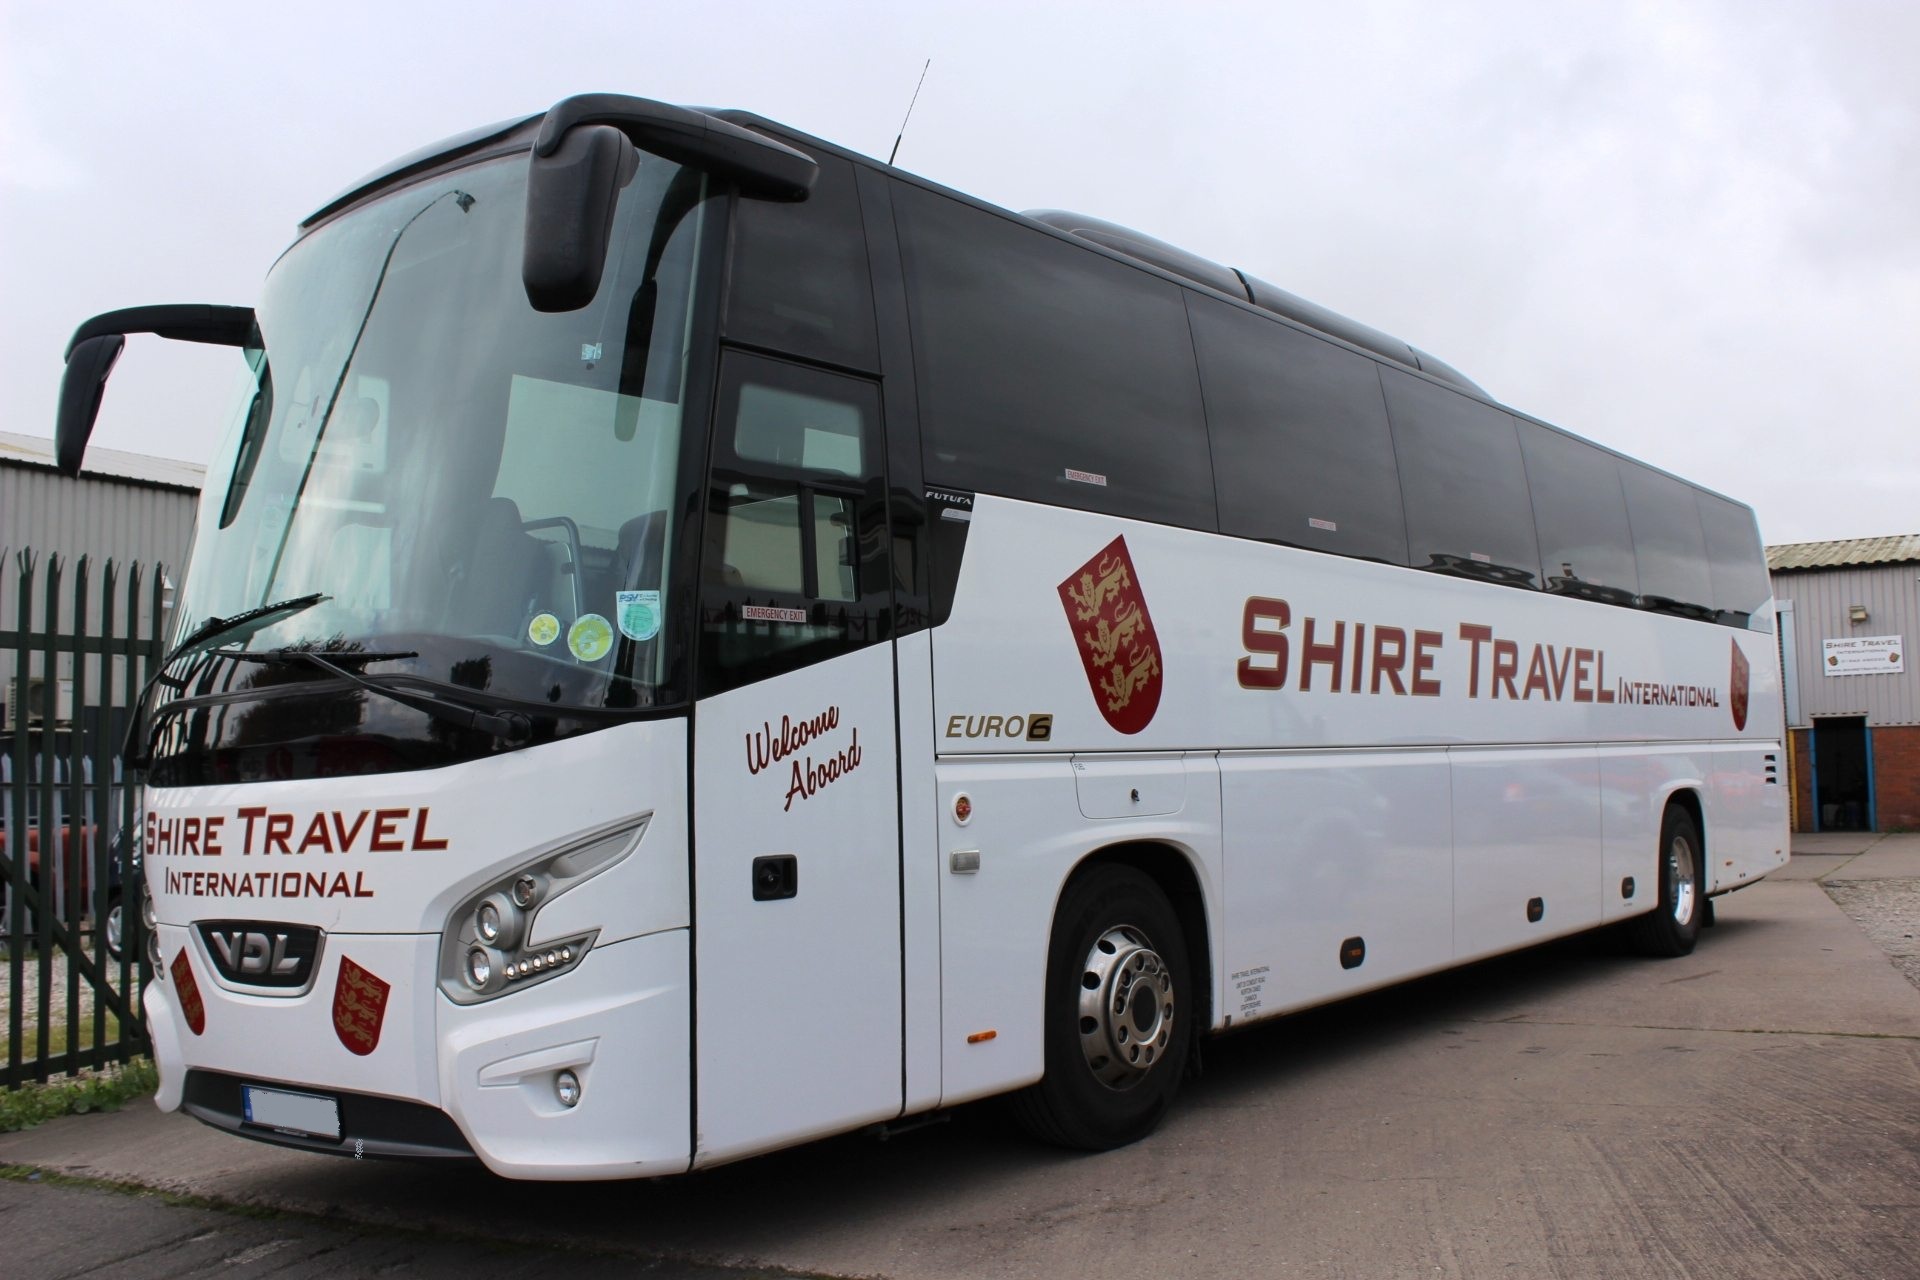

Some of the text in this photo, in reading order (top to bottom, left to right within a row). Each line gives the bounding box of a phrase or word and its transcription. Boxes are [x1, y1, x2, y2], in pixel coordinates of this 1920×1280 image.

[925, 491, 971, 505] FUTURA
[747, 607, 804, 621] EMERGENCY EXIT
[1237, 596, 1719, 708] SHIRE TRAVEL INTERNATIONAL
[746, 706, 839, 775] Welcome
[784, 727, 862, 812] Aboard
[145, 806, 449, 856] SHIRE TRAVEL
[165, 866, 374, 898] INTERNATIONAL
[211, 931, 300, 975] VDL
